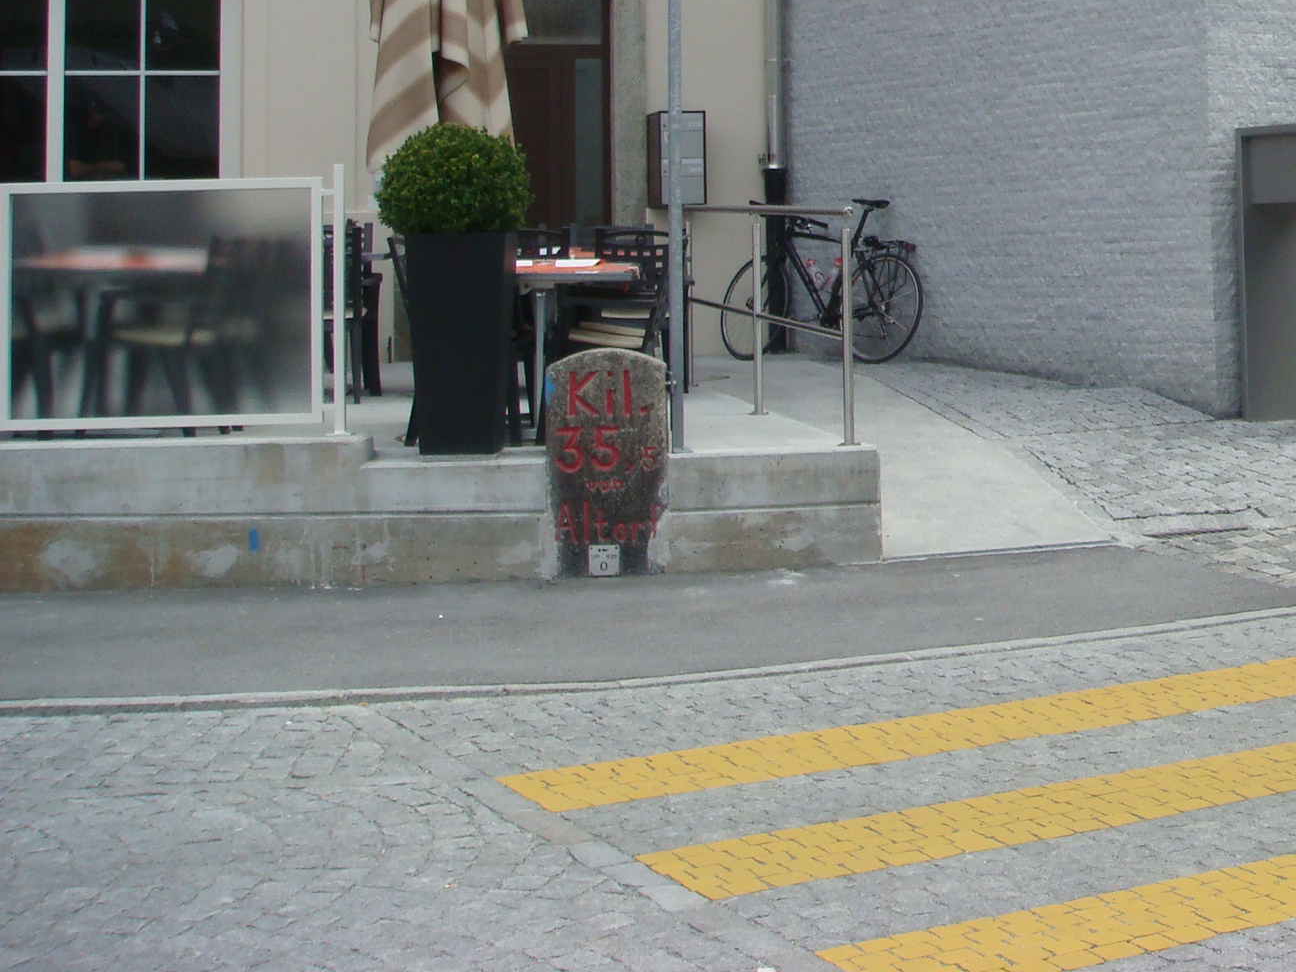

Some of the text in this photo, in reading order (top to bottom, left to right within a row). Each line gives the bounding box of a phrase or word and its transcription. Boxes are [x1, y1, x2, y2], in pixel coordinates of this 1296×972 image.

[566, 370, 649, 417] Kil.
[586, 477, 626, 492] von
[554, 500, 663, 545] Altorf
